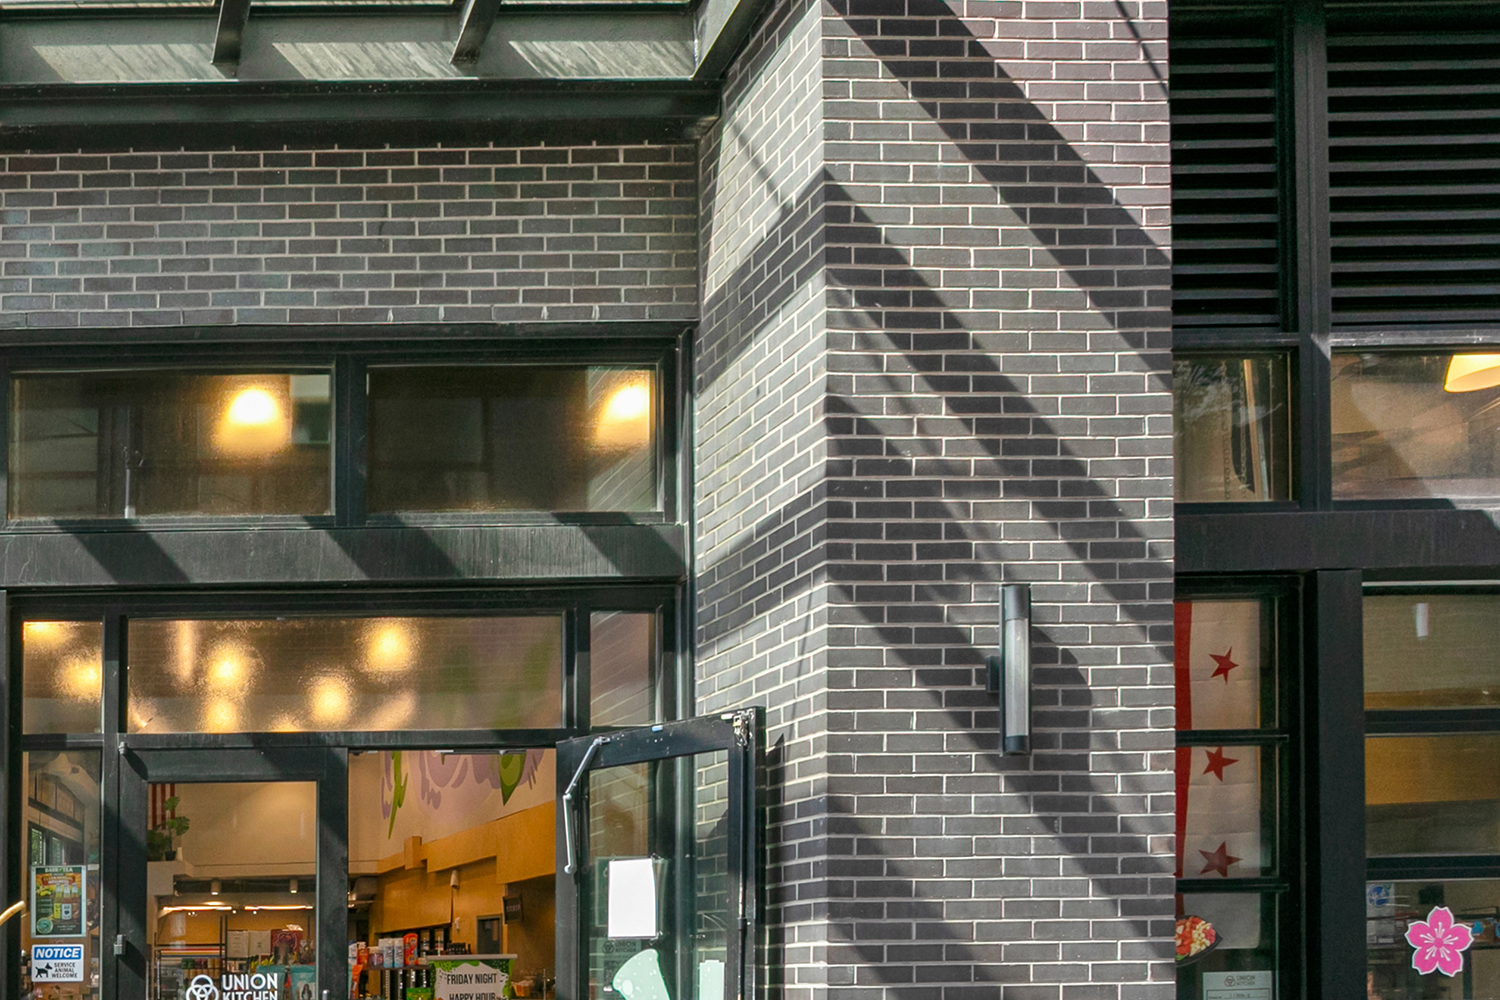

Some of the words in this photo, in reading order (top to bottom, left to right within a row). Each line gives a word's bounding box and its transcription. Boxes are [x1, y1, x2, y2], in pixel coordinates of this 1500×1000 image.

[35, 948, 81, 958] NOTICE
[222, 973, 278, 991] UNION
[446, 973, 474, 985] FRIDAY
[474, 973, 498, 984] NIGHT
